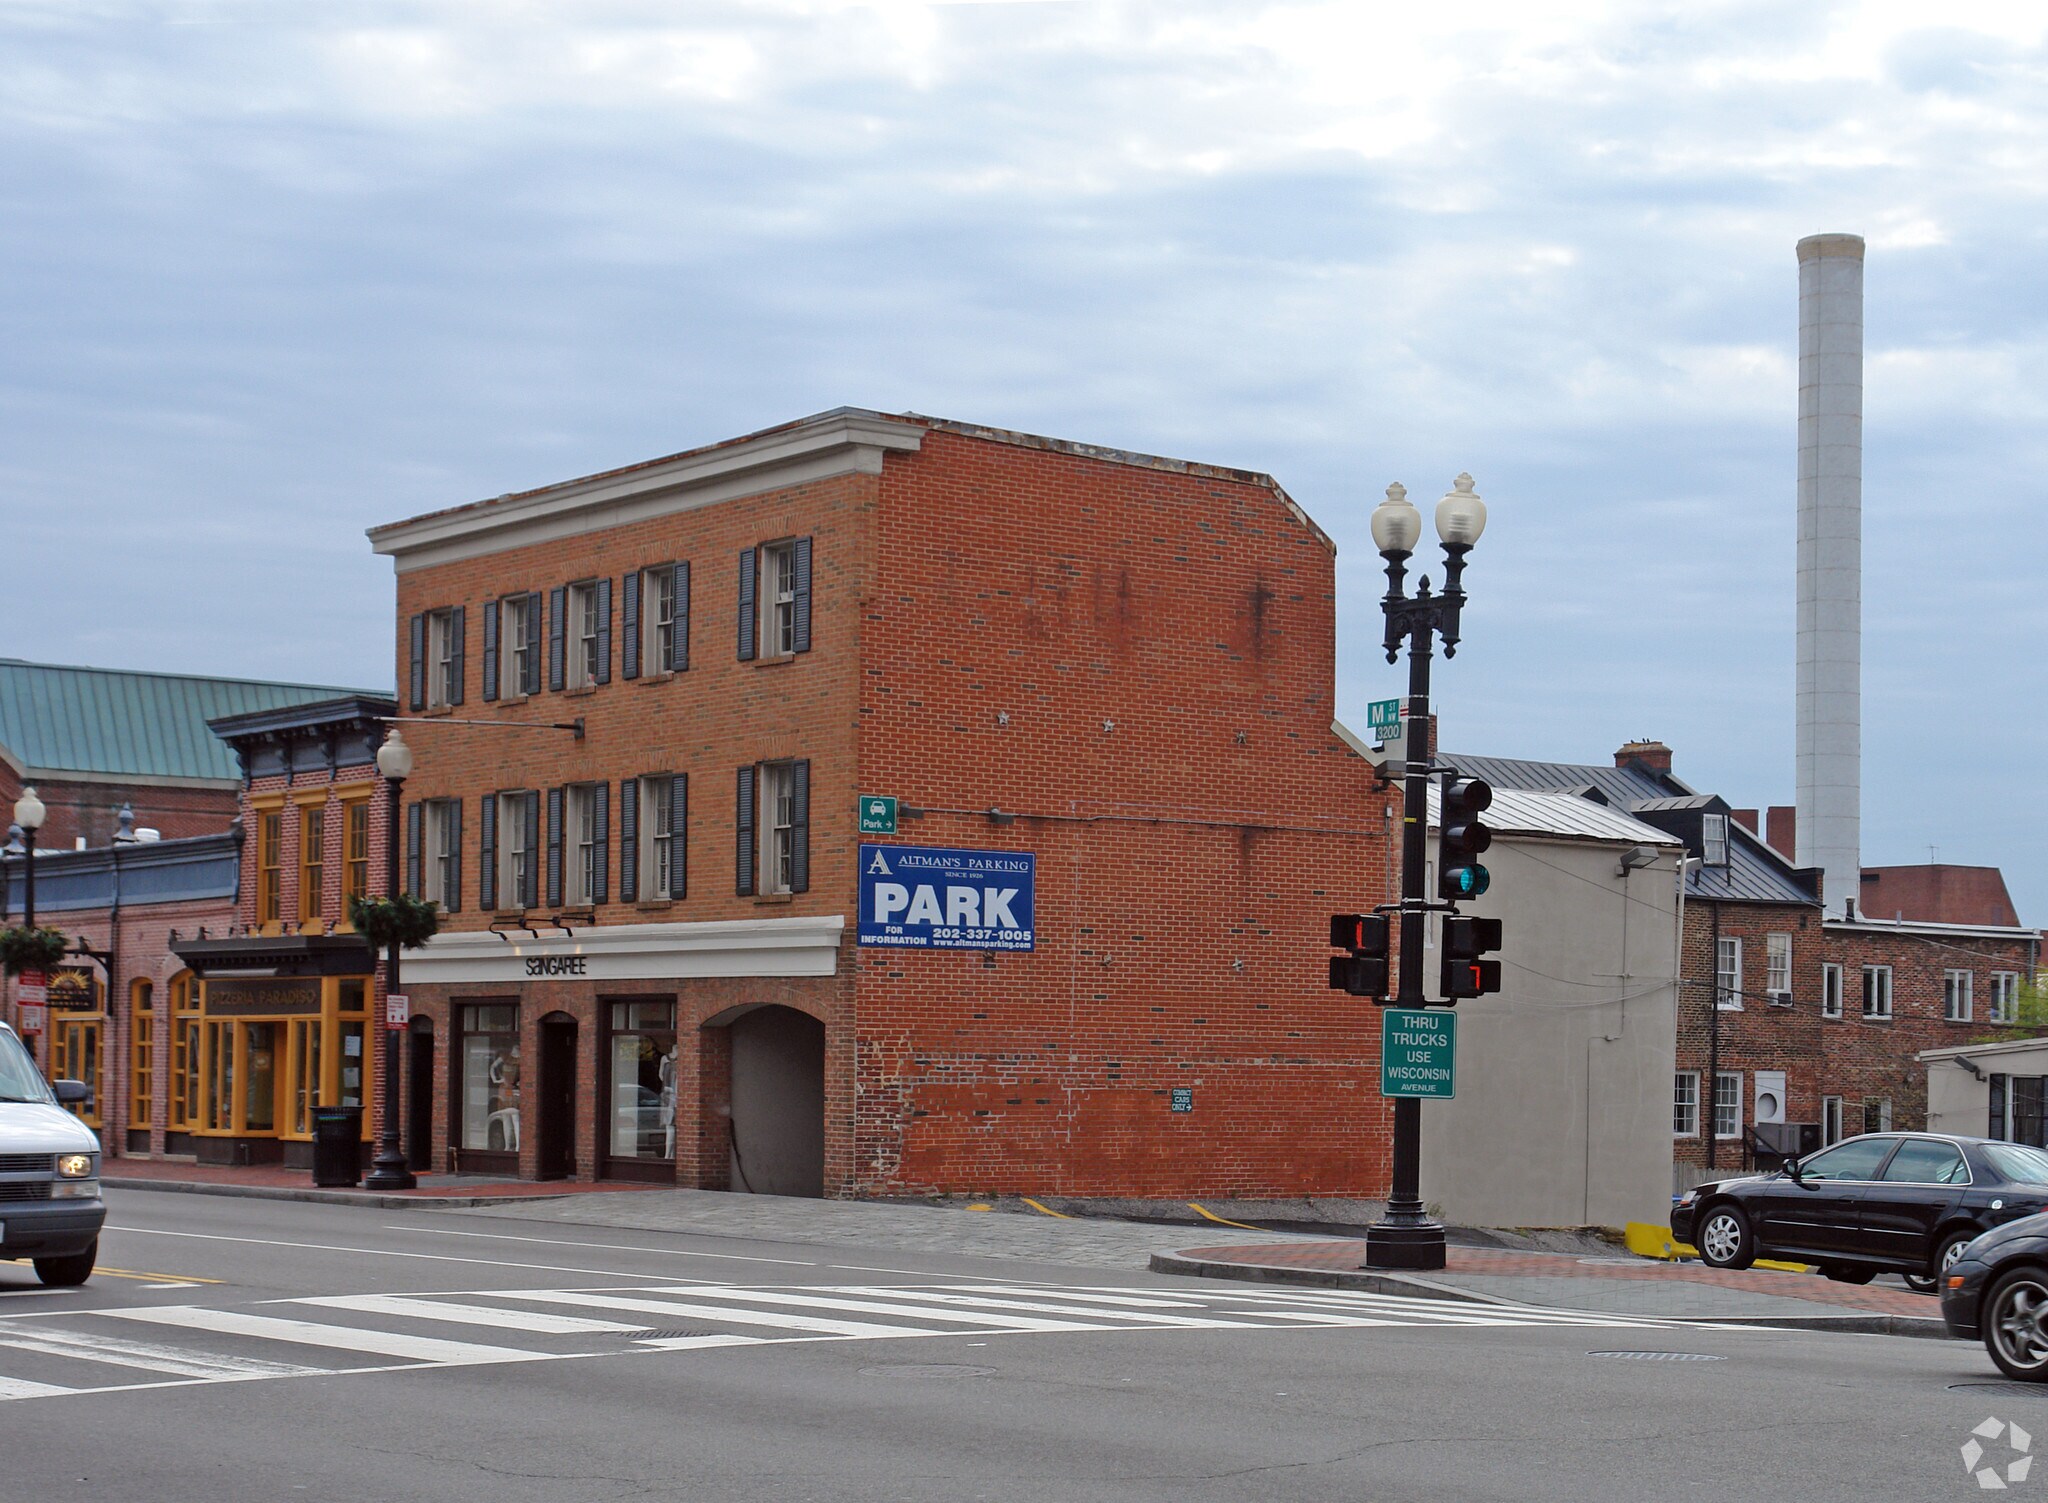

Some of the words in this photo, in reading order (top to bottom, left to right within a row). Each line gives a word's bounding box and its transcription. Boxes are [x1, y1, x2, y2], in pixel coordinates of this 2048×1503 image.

[1372, 704, 1384, 724] M
[1388, 702, 1396, 711] ST
[1388, 713, 1396, 721] NW
[1377, 725, 1399, 739] 3200
[863, 819, 883, 829] Park
[867, 849, 893, 875] A
[898, 855, 960, 867] ALTMAN'S
[968, 858, 1029, 871] PARKING
[874, 882, 1019, 928] PARK
[885, 926, 903, 934] FOR
[933, 928, 1031, 941] 202-337-1005
[861, 935, 927, 945] INFORMATION
[933, 939, 1031, 949] www.altmansparking.com
[211, 991, 254, 1005] PIZZERIA
[259, 988, 317, 1005] PARADISO
[1402, 1016, 1439, 1030] THRU
[1392, 1032, 1447, 1047] TRUCKS
[1407, 1051, 1431, 1063] USE
[1388, 1066, 1450, 1080] WISCONSIN
[1401, 1083, 1437, 1092] AVENUE
[1172, 1103, 1186, 1111] ONLY
